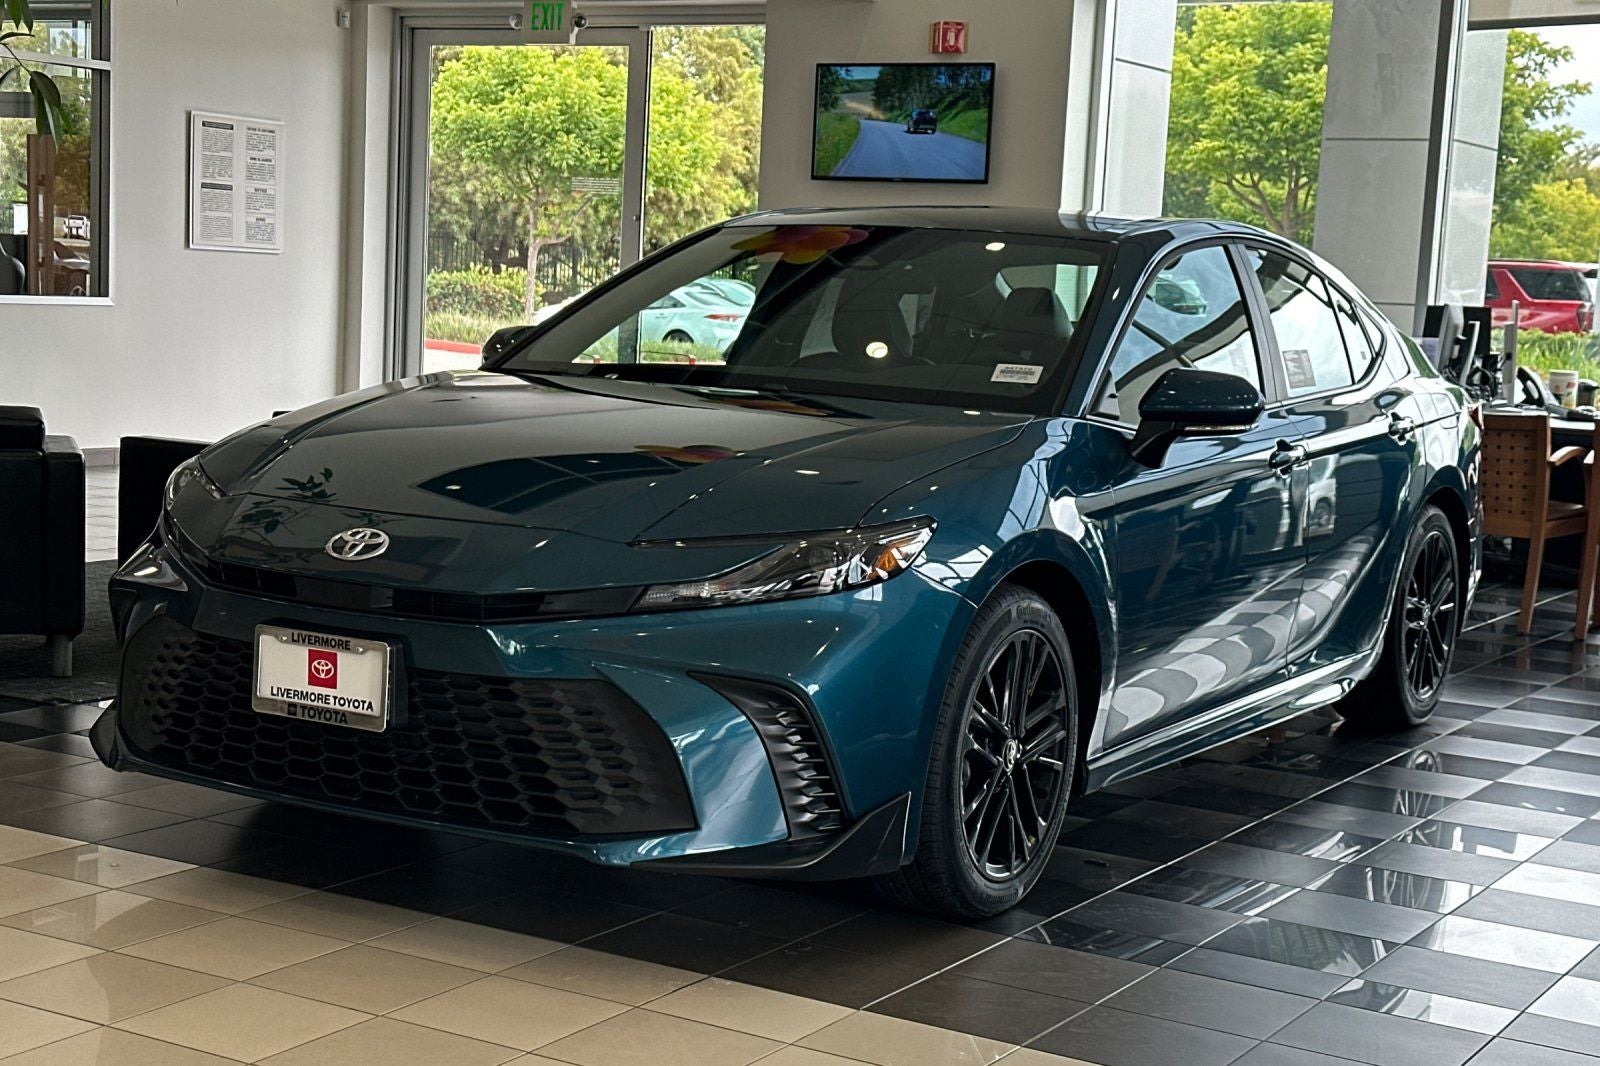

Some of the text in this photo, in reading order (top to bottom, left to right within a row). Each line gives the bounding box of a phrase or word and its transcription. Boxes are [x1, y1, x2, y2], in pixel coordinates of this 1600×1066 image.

[531, 2, 564, 31] EXIT
[291, 632, 351, 651] LIVERMORE
[270, 686, 374, 712] LIVERMORE TOYOTA
[300, 705, 348, 724] TOYOTA
